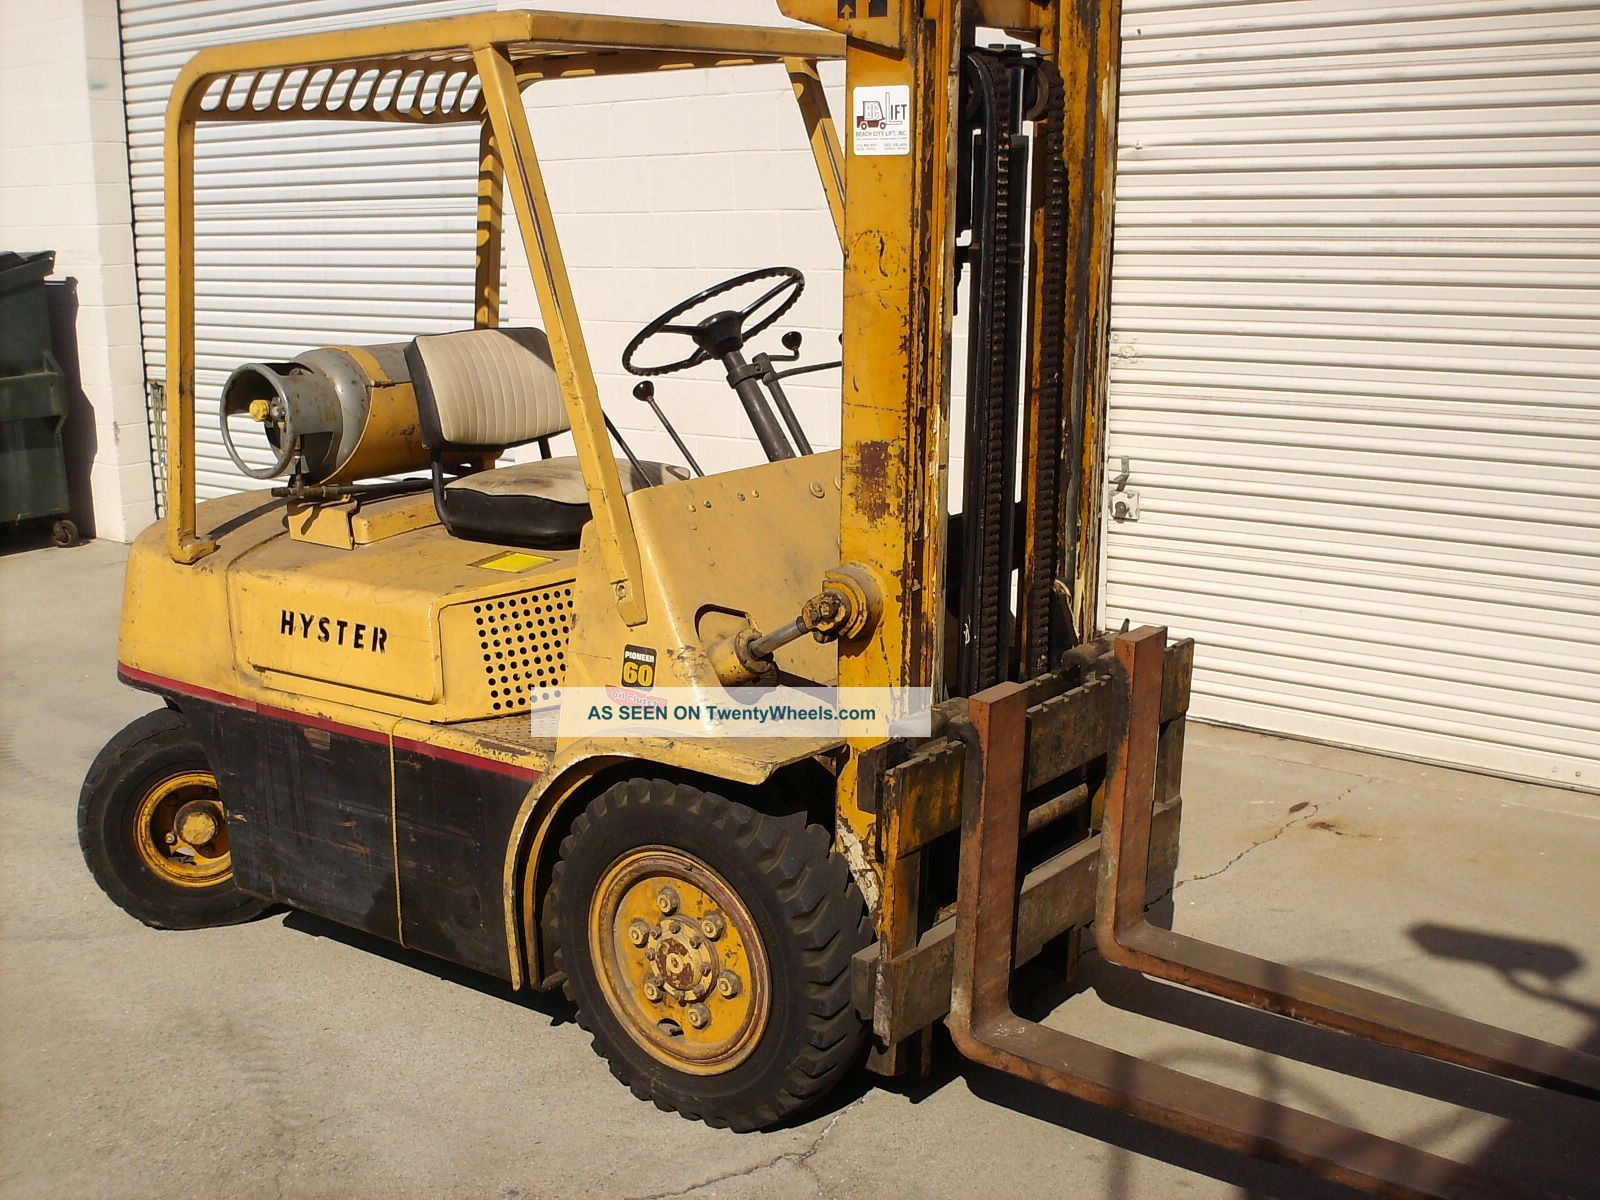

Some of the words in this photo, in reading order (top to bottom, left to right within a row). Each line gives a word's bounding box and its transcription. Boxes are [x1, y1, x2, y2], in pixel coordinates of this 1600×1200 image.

[280, 609, 388, 653] HYSTER
[624, 650, 655, 663] PIONEER
[623, 661, 653, 687] 60
[612, 689, 625, 699] oil
